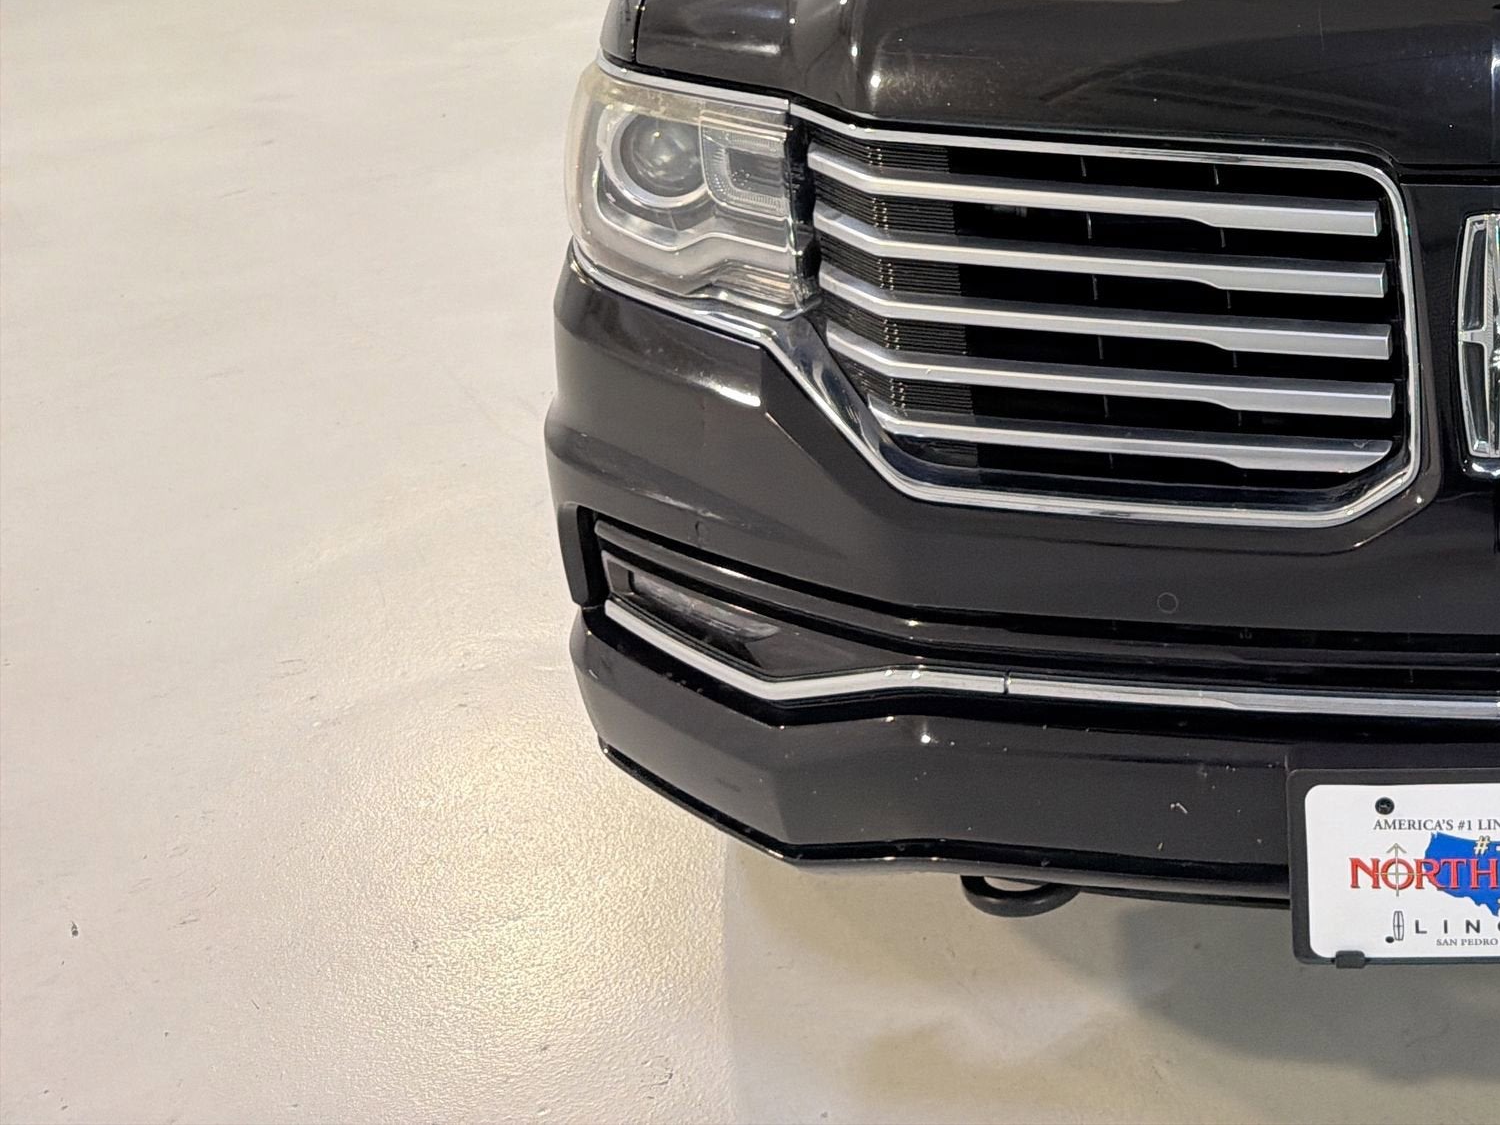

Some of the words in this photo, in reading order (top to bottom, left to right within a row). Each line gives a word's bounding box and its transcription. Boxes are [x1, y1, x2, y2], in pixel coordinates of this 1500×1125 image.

[1373, 818, 1454, 831] AMERICA'S
[1457, 818, 1472, 831] #1
[1349, 857, 1498, 890] NORTH
[1436, 938, 1458, 947] SAN
[1461, 937, 1499, 947] PEDRO
